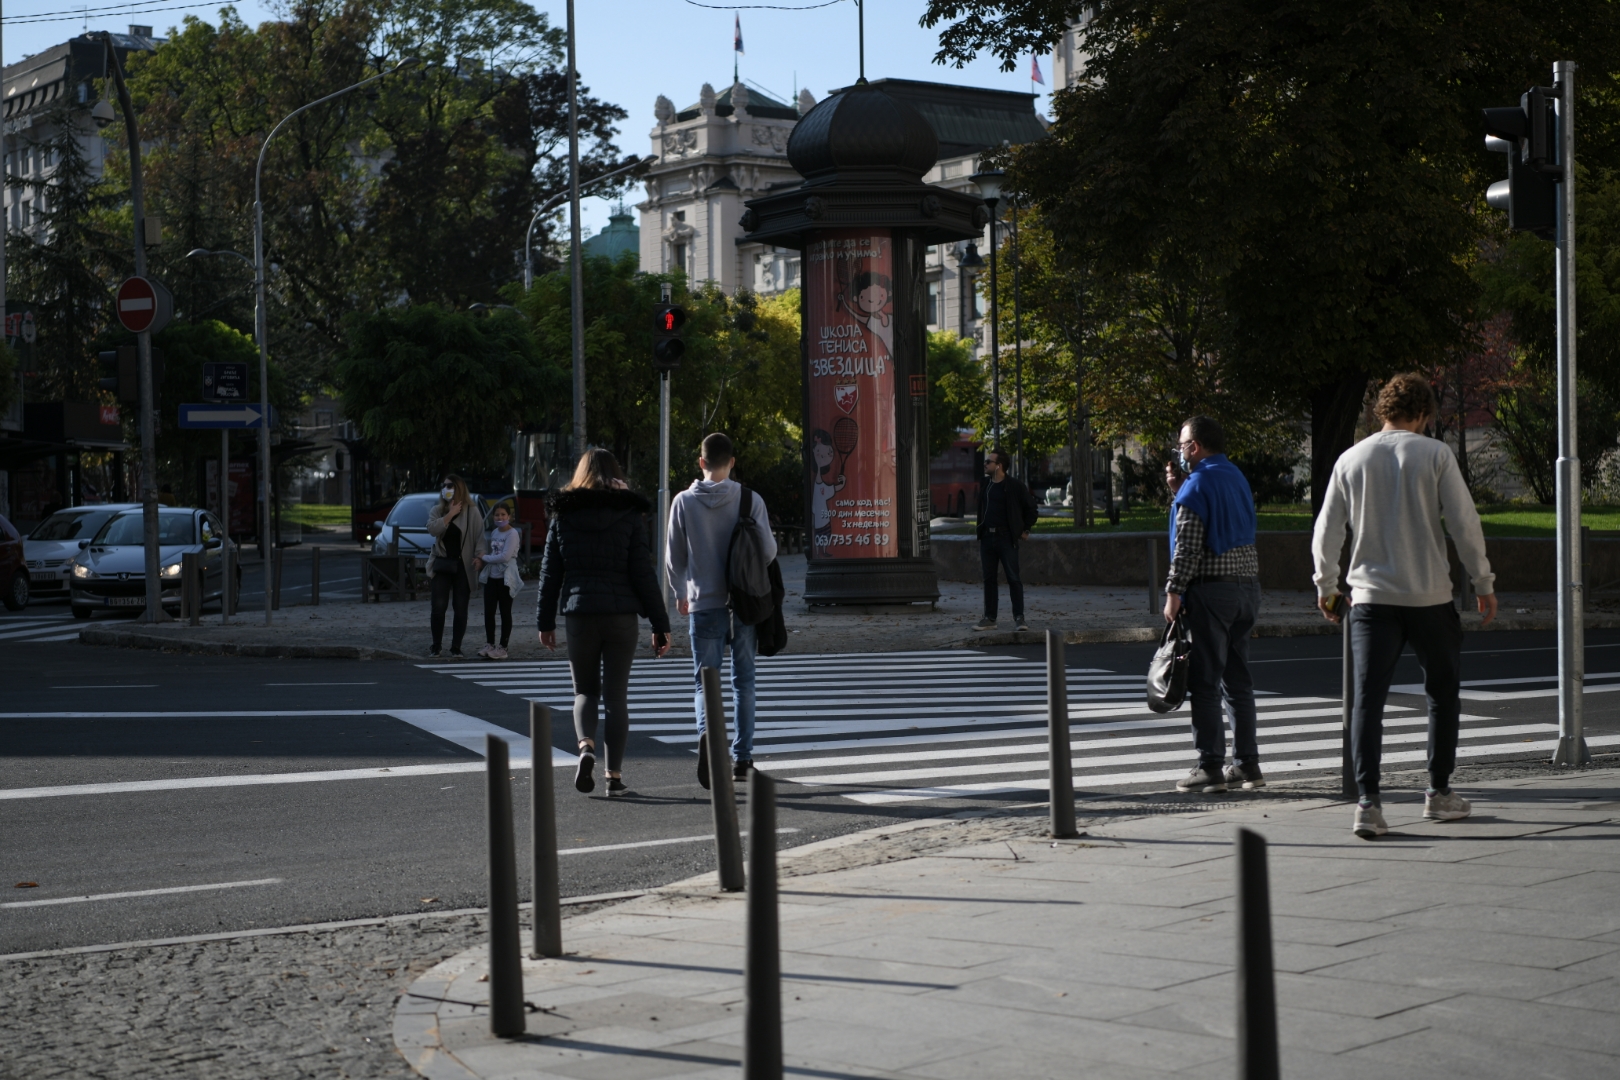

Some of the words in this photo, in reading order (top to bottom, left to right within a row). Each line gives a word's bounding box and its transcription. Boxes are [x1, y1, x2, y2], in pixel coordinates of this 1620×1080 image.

[843, 239, 856, 249] да
[859, 238, 870, 246] се
[837, 250, 844, 259] и
[845, 246, 882, 261] учимо!
[820, 324, 862, 338] ШКОЛА
[818, 339, 868, 354] ТЕНИСА
[809, 355, 889, 378] "ЗВЕЗДИЦА"
[835, 499, 855, 507] само
[857, 499, 873, 507] код
[874, 497, 891, 507] нас!
[838, 509, 853, 518] дин
[854, 509, 890, 517] месечно
[852, 520, 890, 529] недељно
[814, 533, 853, 546] 063/735
[854, 533, 871, 546] 46
[874, 533, 889, 546] 89
